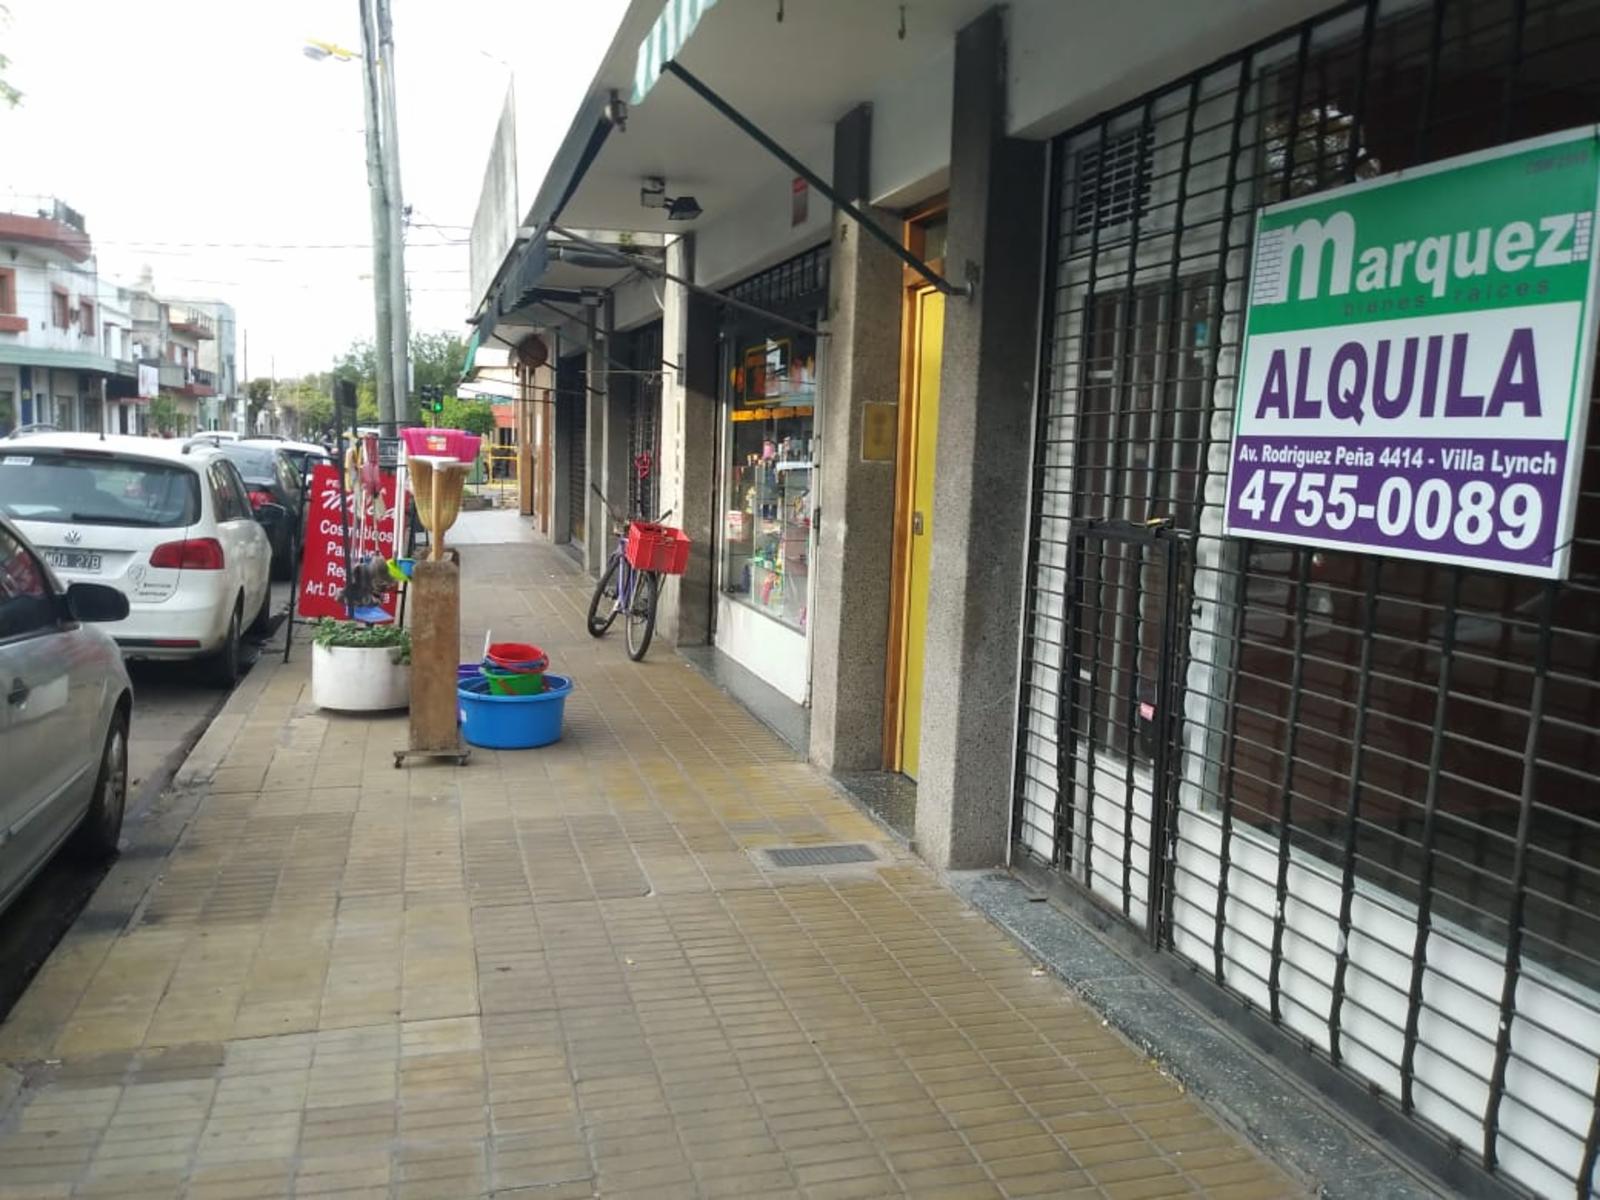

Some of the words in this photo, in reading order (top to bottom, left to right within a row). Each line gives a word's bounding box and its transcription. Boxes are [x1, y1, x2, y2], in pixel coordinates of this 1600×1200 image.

[1255, 328, 1542, 425] ALQUILA
[1239, 444, 1258, 463] Av.
[1335, 446, 1374, 467] Peña
[1379, 447, 1423, 468] 4414
[1441, 449, 1483, 471] Villa
[1491, 451, 1557, 477] Lynch
[1238, 469, 1543, 551] 4755-0089
